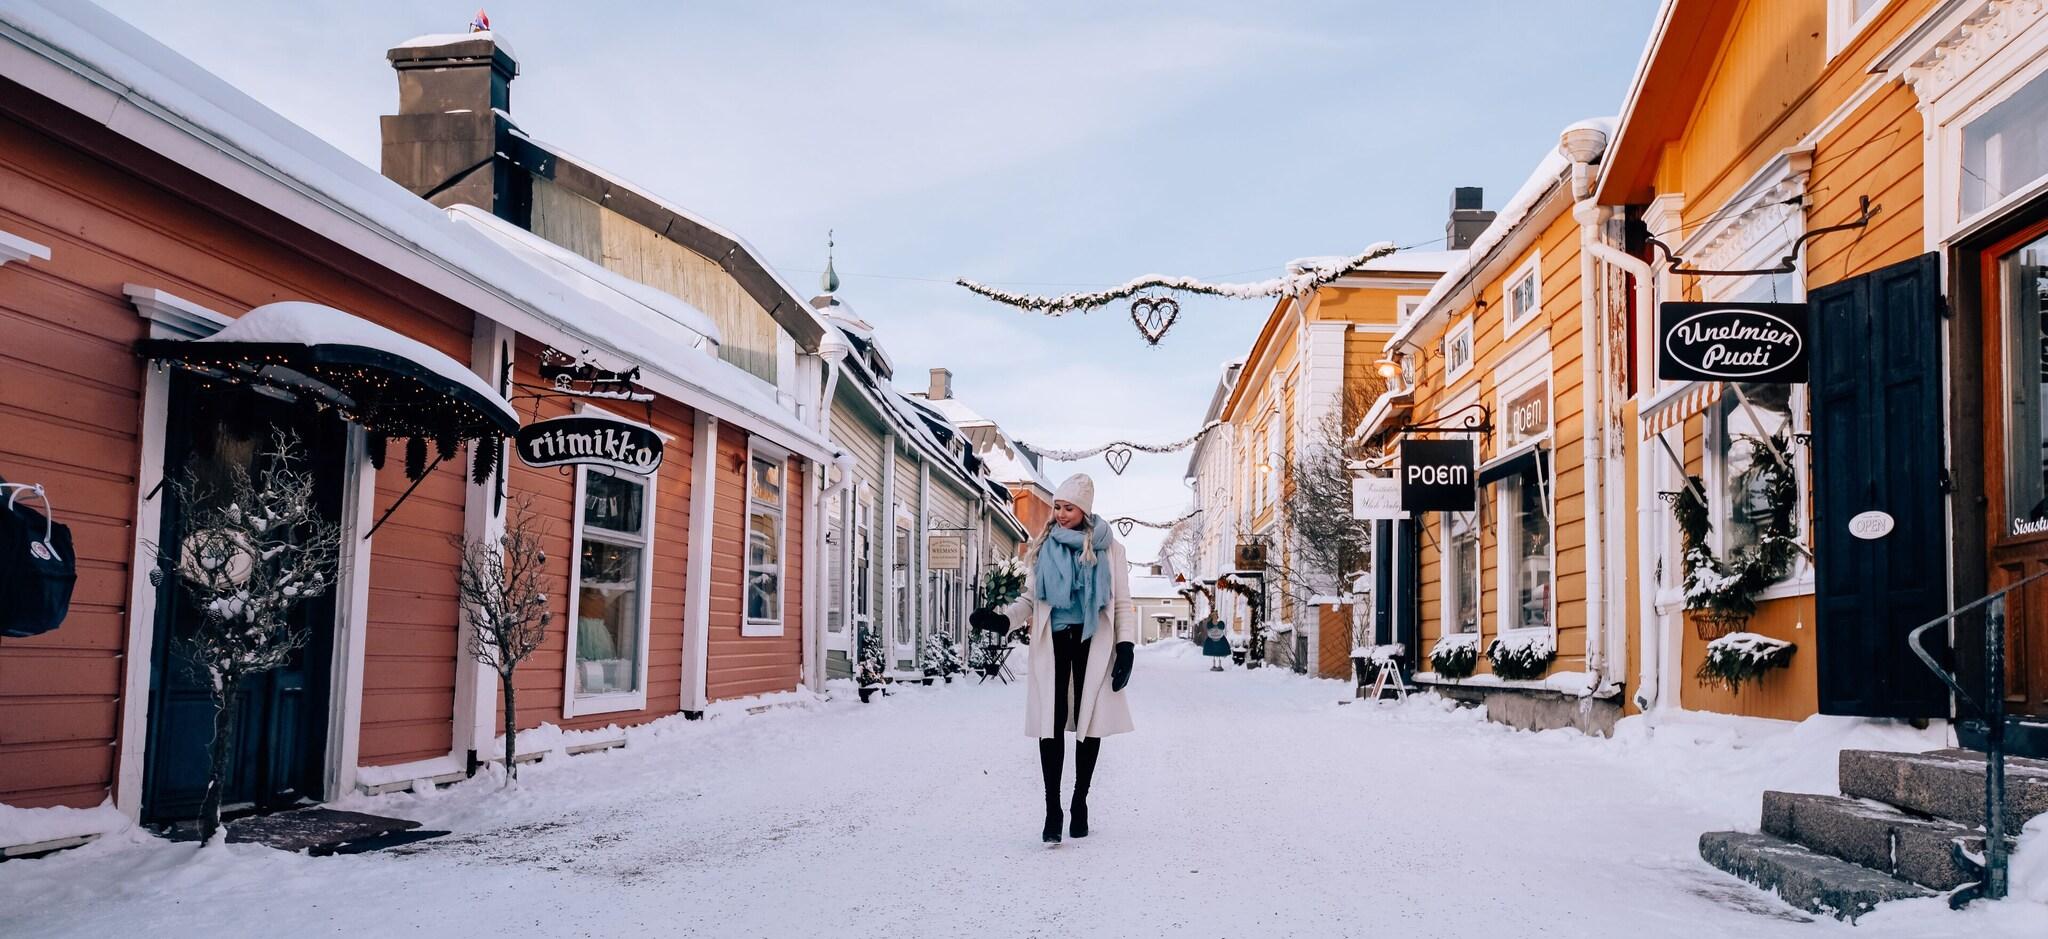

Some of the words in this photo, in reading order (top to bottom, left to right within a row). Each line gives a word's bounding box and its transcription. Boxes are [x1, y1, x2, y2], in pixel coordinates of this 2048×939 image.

[1677, 319, 1794, 346] Unelmien
[1702, 344, 1772, 370] Puoti
[529, 429, 652, 466] riimikko
[1408, 465, 1467, 485] POEM
[1857, 519, 1886, 533] OPEN
